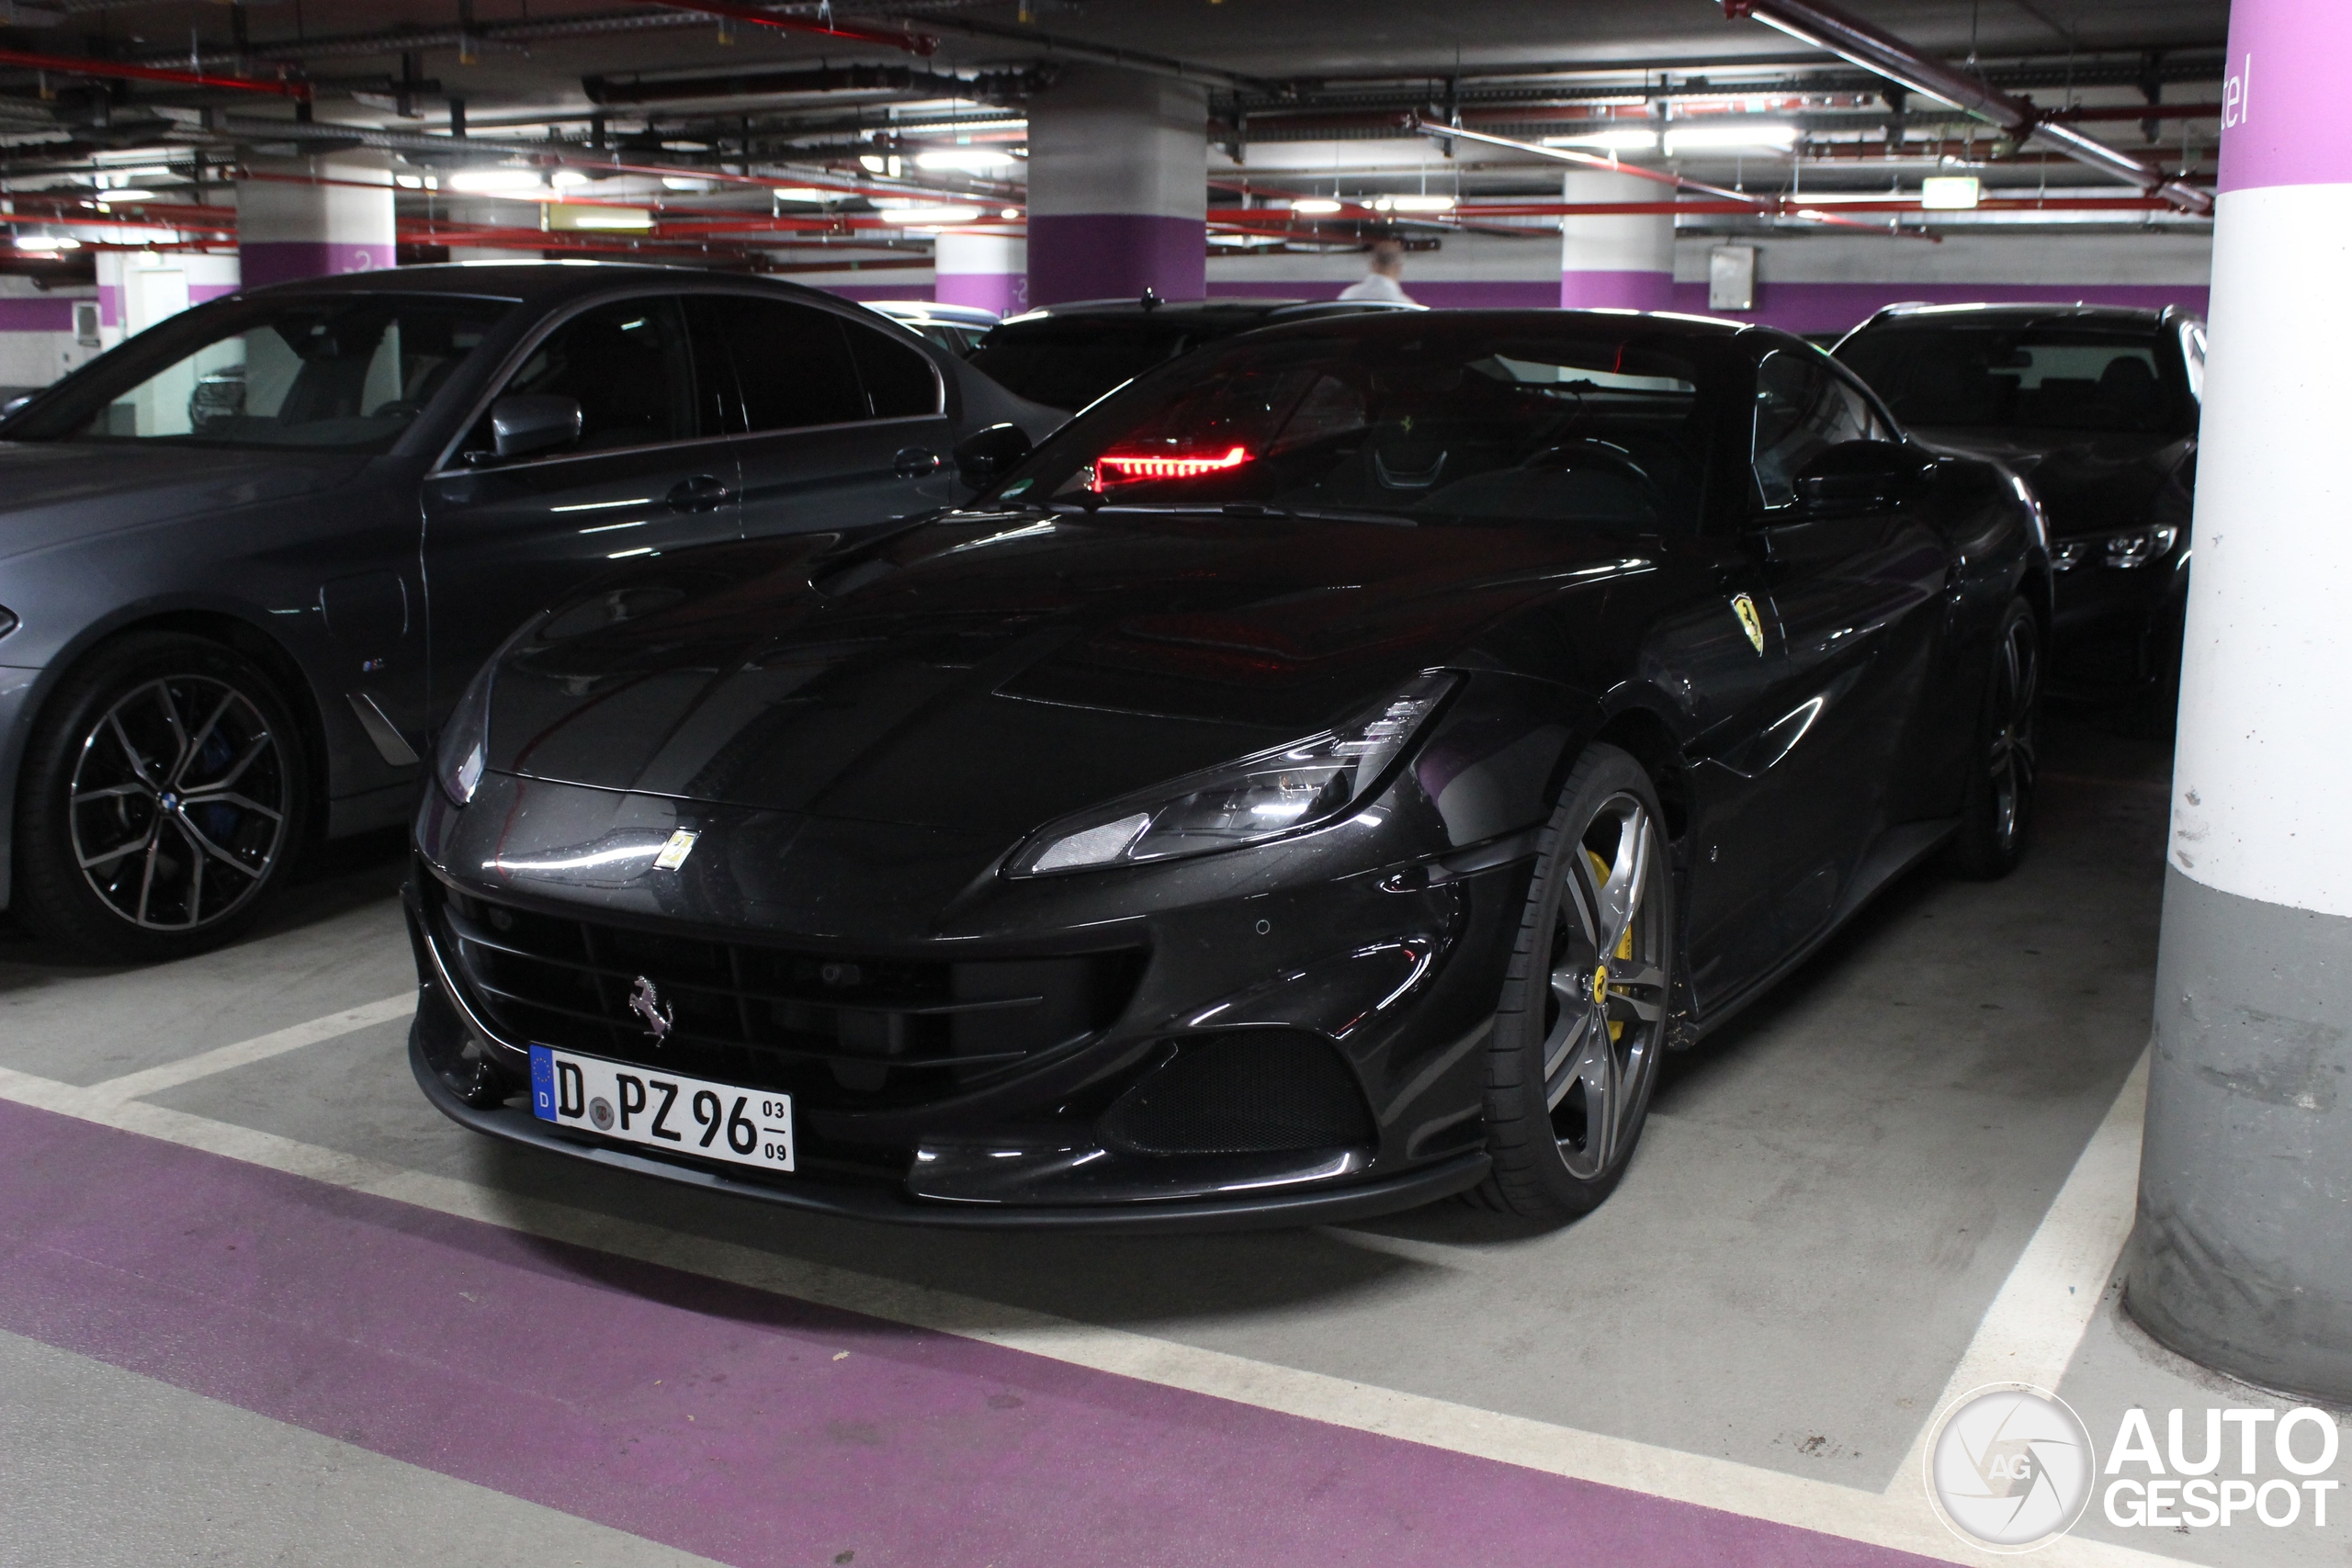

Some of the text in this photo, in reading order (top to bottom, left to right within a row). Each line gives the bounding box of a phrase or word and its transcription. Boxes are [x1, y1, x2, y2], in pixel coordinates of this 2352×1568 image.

[555, 1060, 585, 1119] D
[539, 1091, 549, 1109] D
[763, 1100, 785, 1119] 03
[764, 1143, 786, 1161] 09
